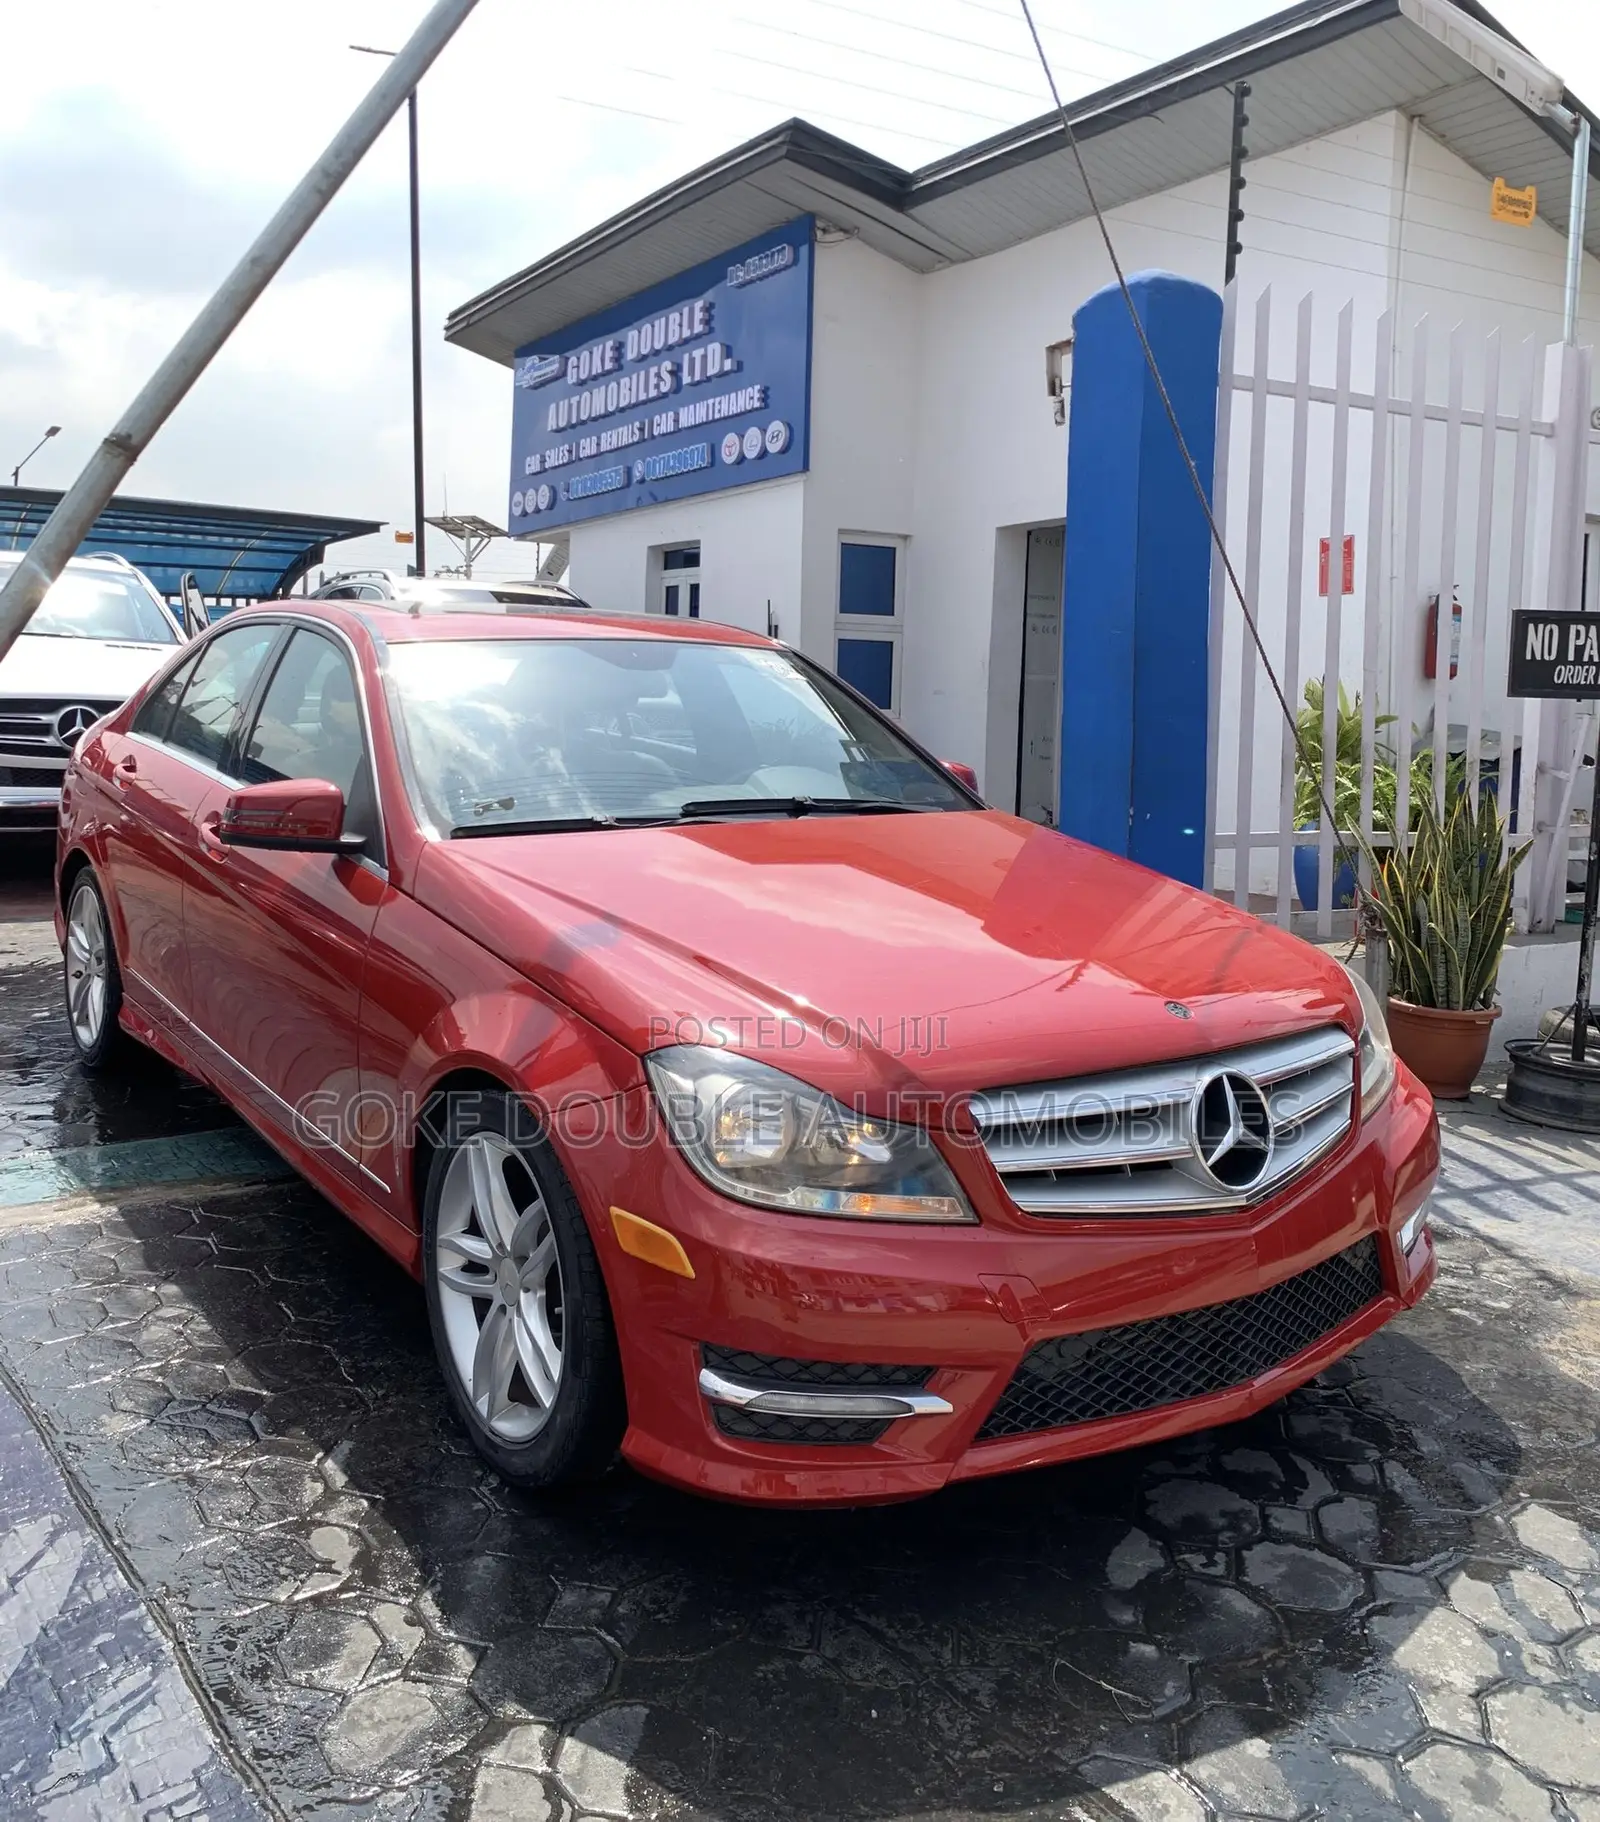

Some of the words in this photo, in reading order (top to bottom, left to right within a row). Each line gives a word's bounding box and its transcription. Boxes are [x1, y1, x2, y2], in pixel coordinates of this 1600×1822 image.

[567, 339, 615, 385] GOKE
[627, 299, 705, 361] DOUBLE
[547, 360, 673, 431] AUTOMOBILES
[682, 341, 732, 386] LTD.
[525, 453, 541, 475] CAR
[545, 443, 570, 469] SALES
[579, 435, 598, 458] CAR
[600, 421, 641, 453] RENTALS
[653, 411, 675, 436] CAR
[678, 384, 762, 429] MAINTENANCE
[1525, 623, 1559, 661] NO
[1567, 624, 1599, 663] PA
[1553, 665, 1596, 685] ORDER
